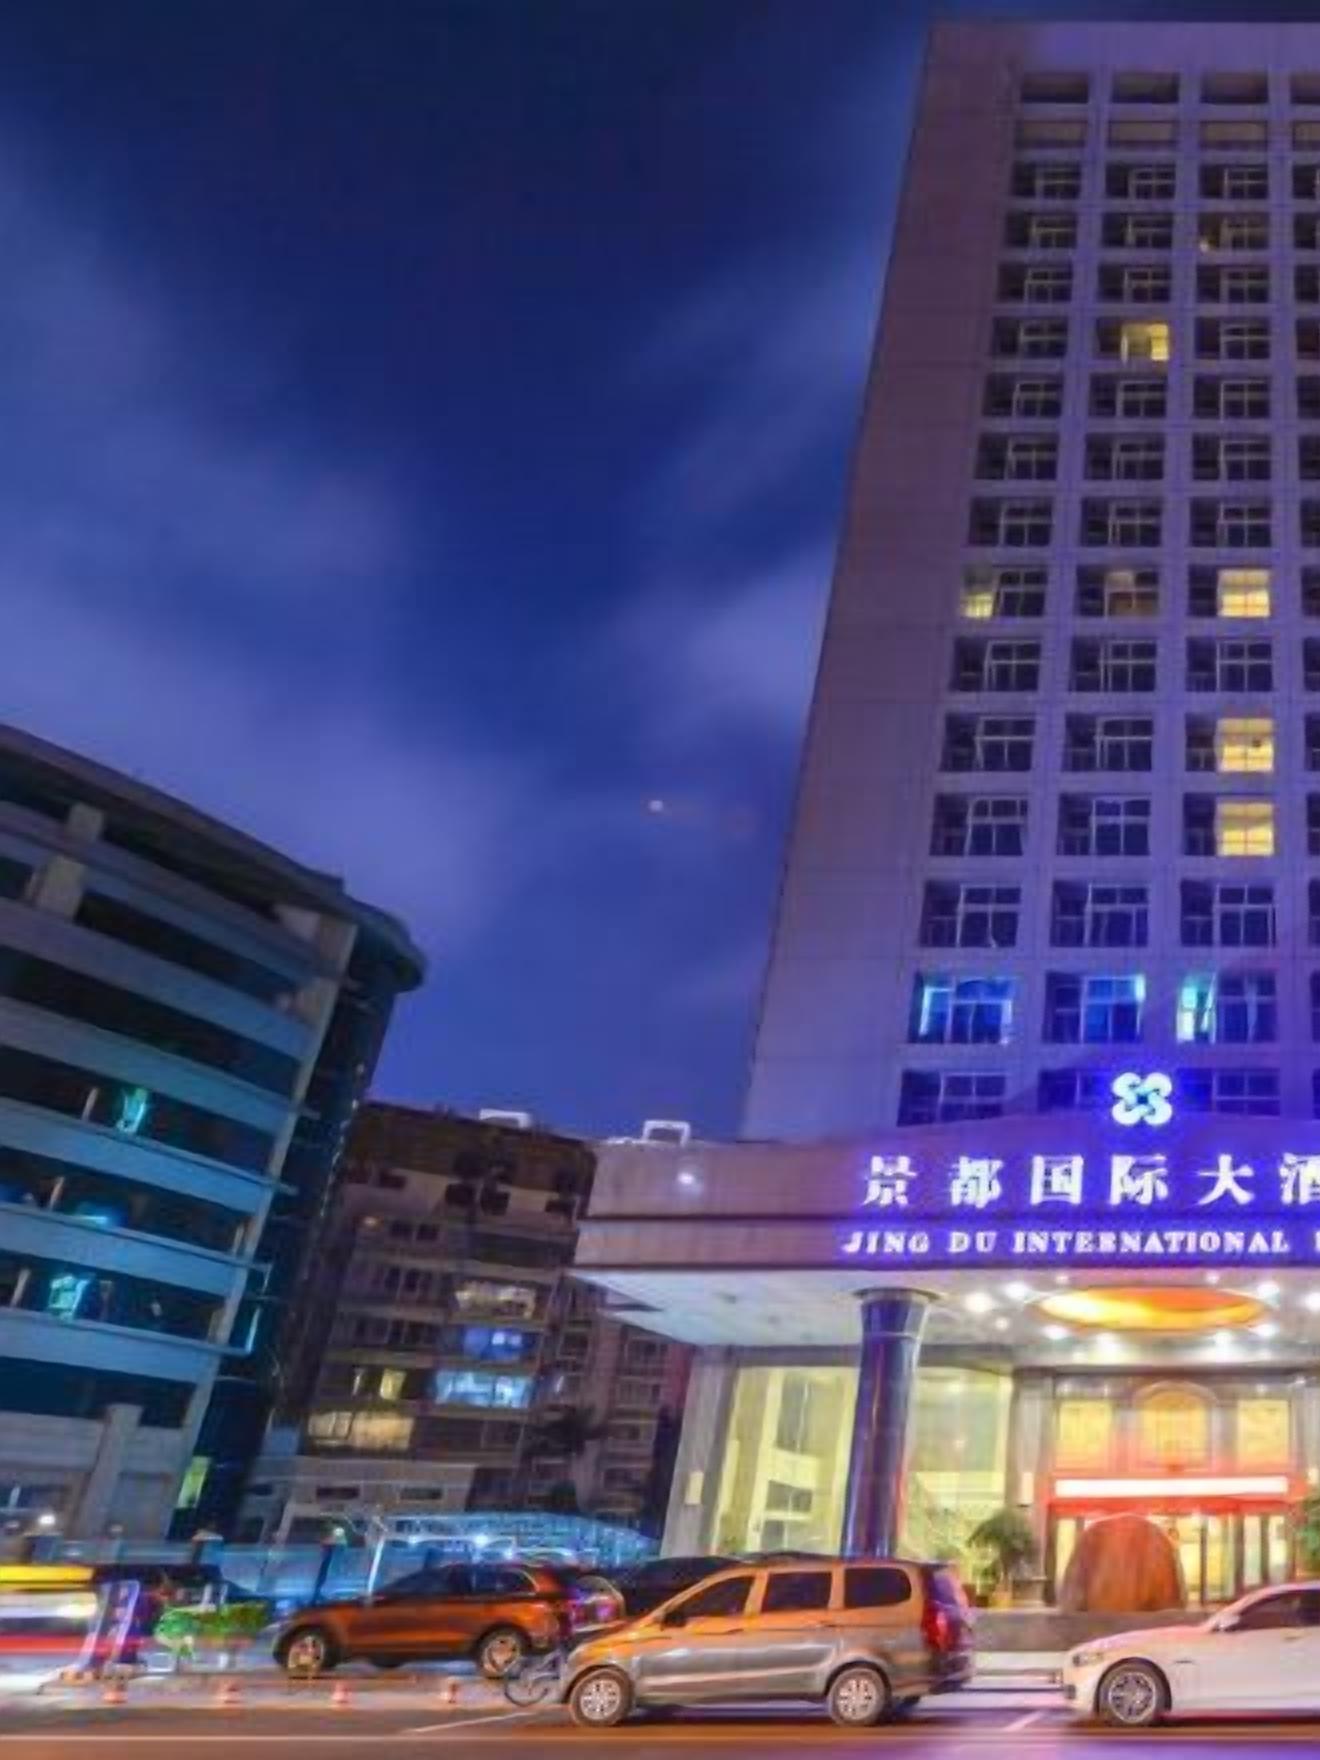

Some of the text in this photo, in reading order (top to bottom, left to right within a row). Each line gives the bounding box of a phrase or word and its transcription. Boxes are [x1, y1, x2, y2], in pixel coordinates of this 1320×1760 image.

[842, 1230, 930, 1253] JING
[949, 1230, 998, 1253] DU
[1013, 1229, 1291, 1253] INTERNATIONAL
